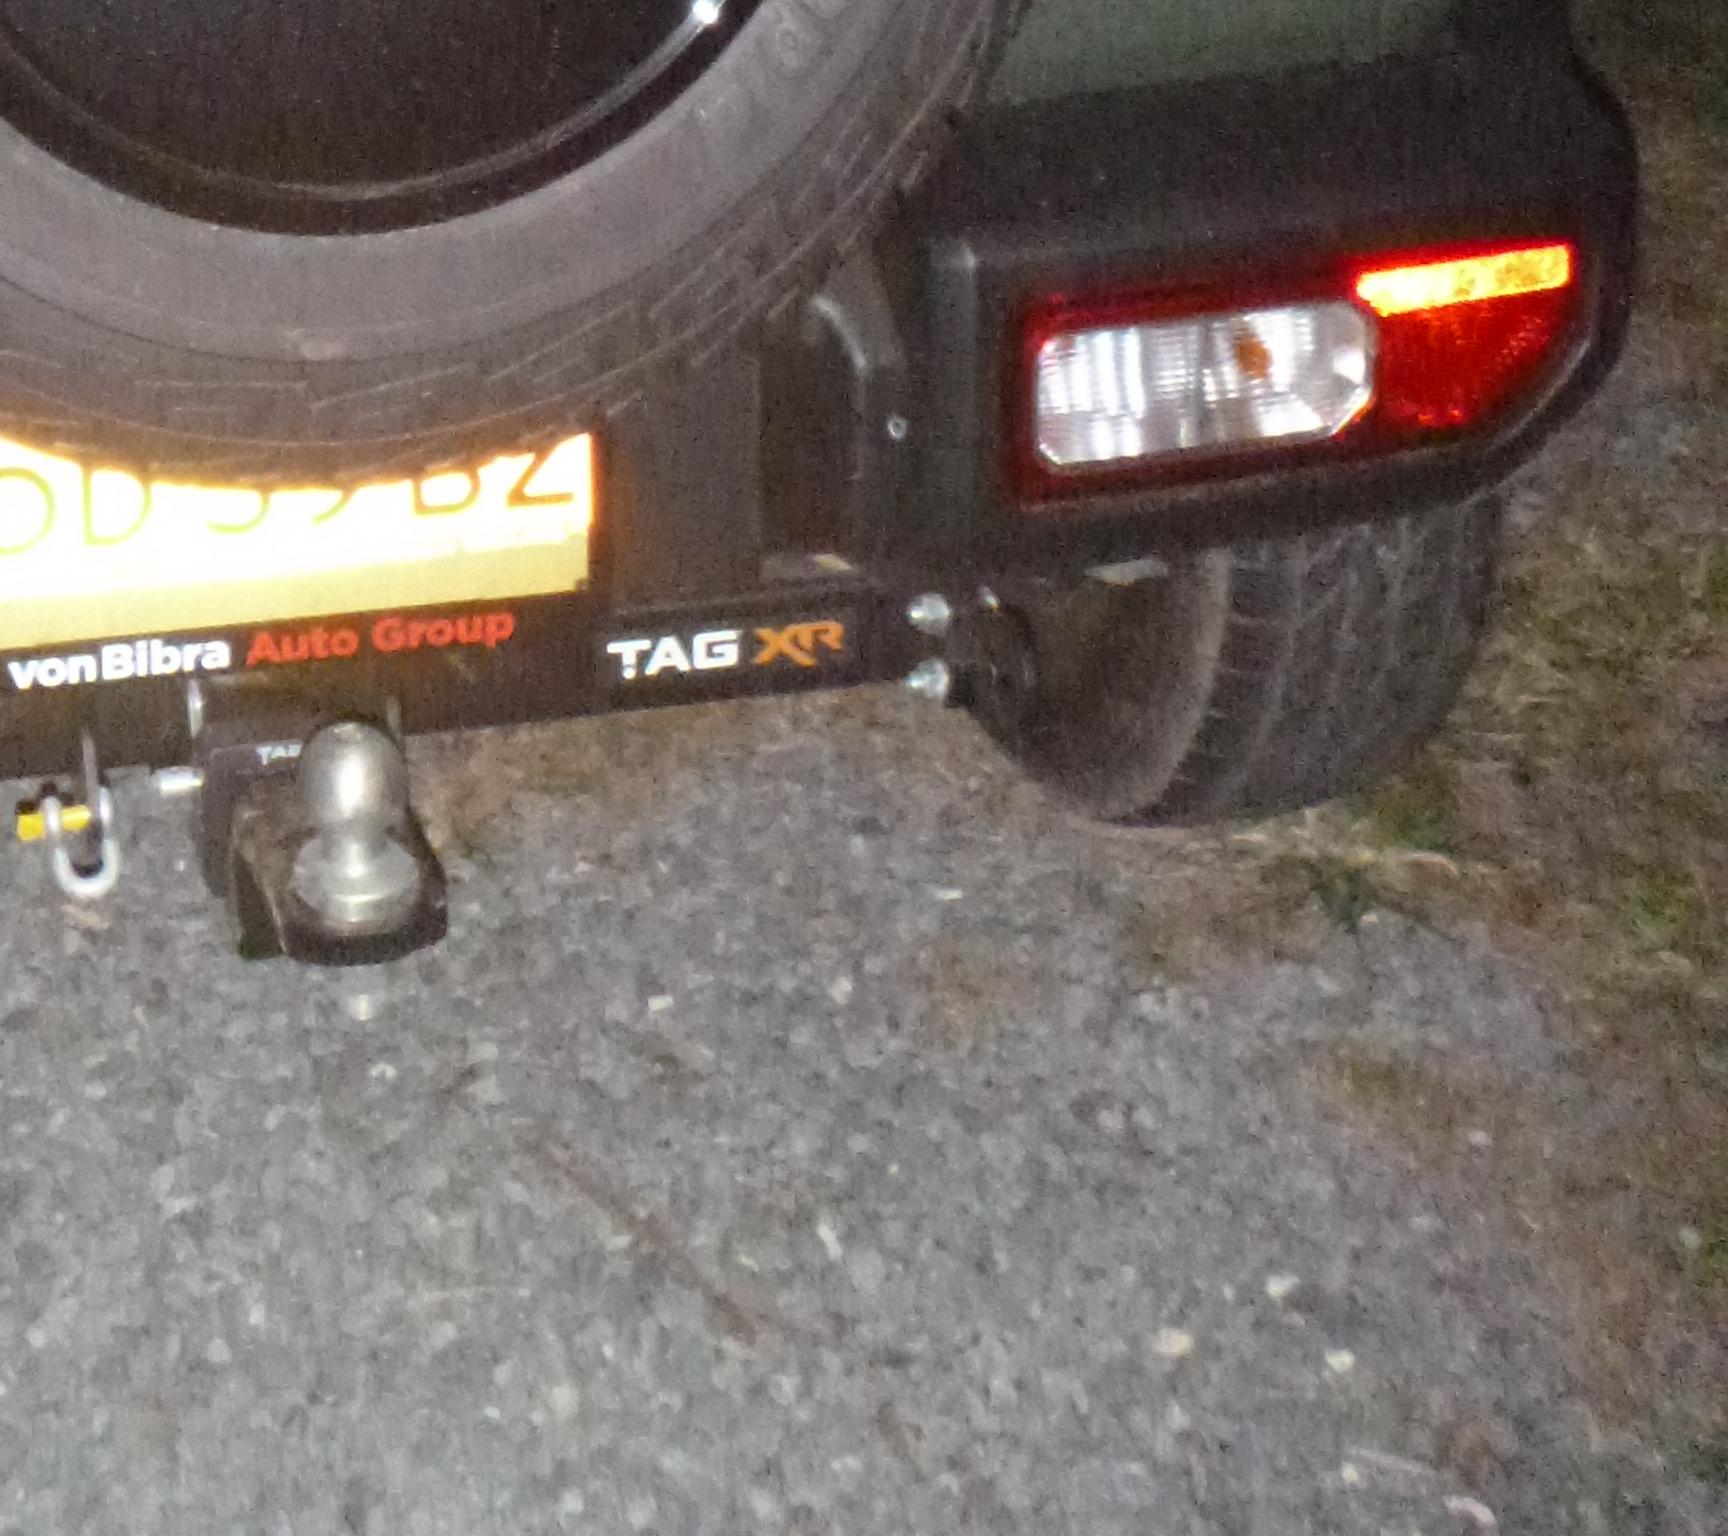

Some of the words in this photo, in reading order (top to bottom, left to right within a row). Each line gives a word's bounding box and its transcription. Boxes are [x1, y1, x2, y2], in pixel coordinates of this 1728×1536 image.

[246, 628, 359, 666] Auto
[372, 612, 515, 653] Group
[607, 630, 739, 679] TAG
